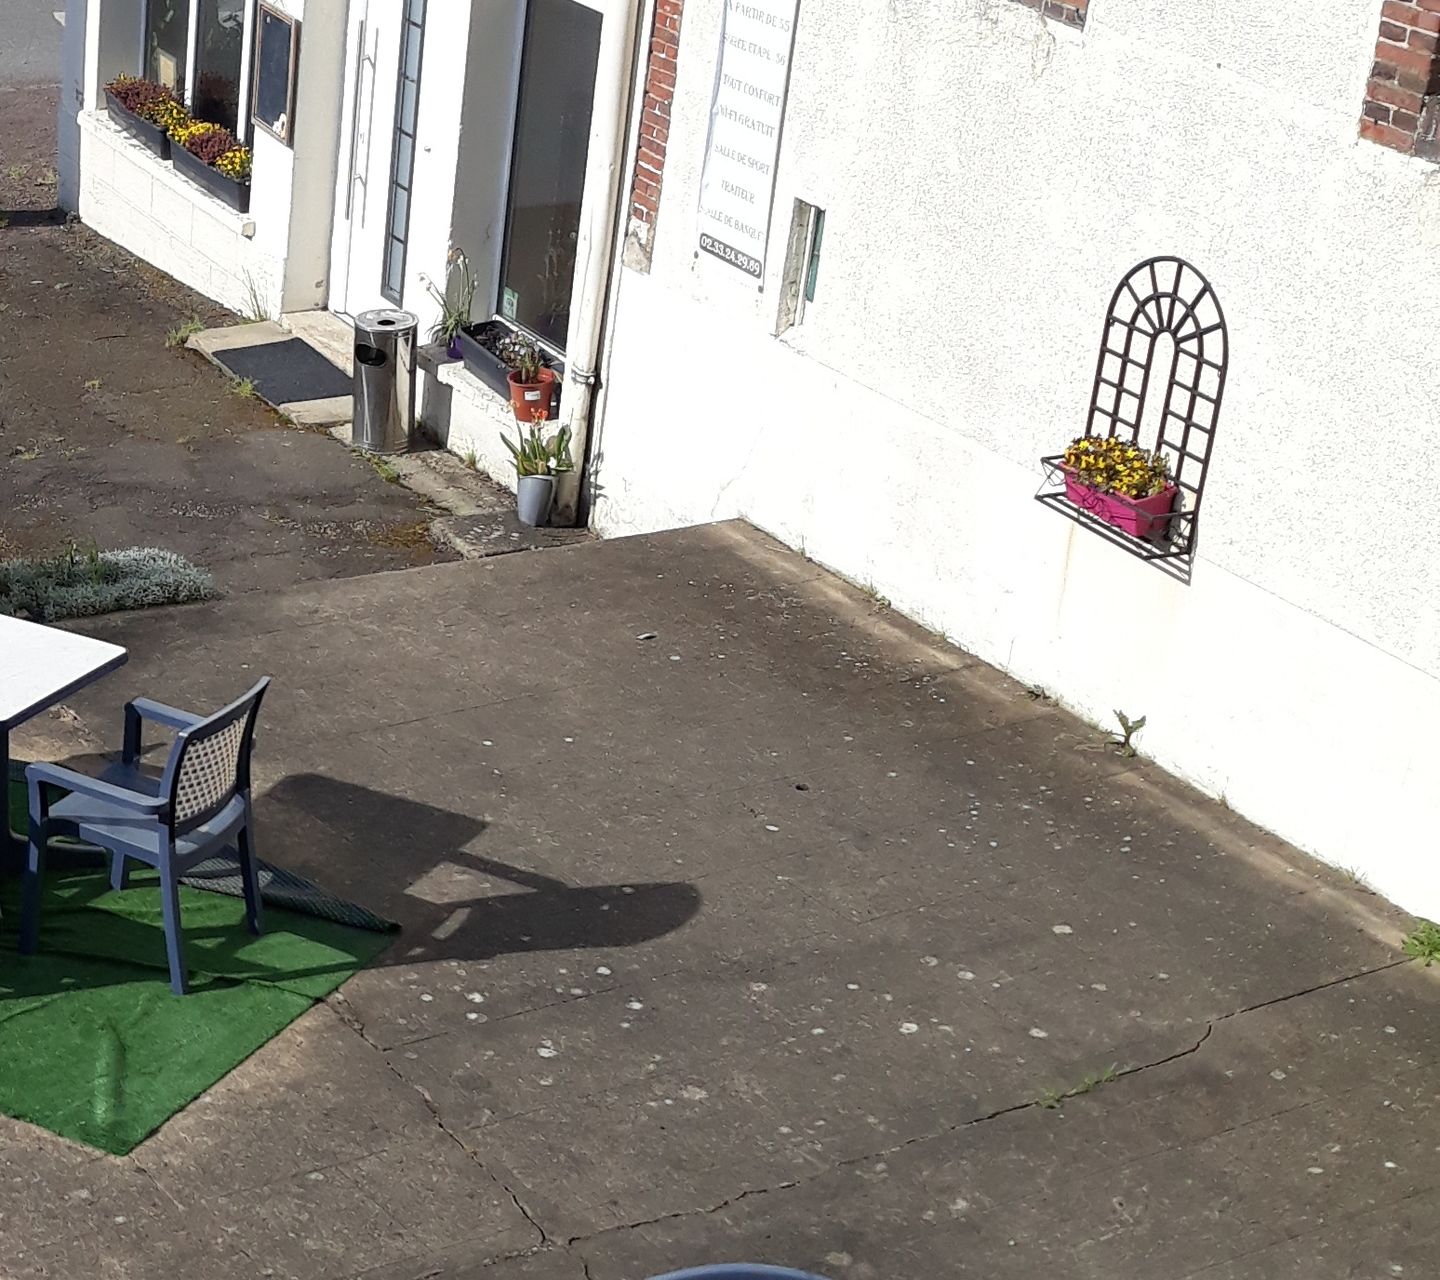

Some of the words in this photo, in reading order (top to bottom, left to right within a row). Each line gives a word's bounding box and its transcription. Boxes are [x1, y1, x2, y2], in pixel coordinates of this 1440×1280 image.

[735, 1, 765, 24] PARTIR
[765, 13, 778, 27] DE
[743, 82, 782, 107] CONFORT
[738, 113, 776, 138] GRATUIT
